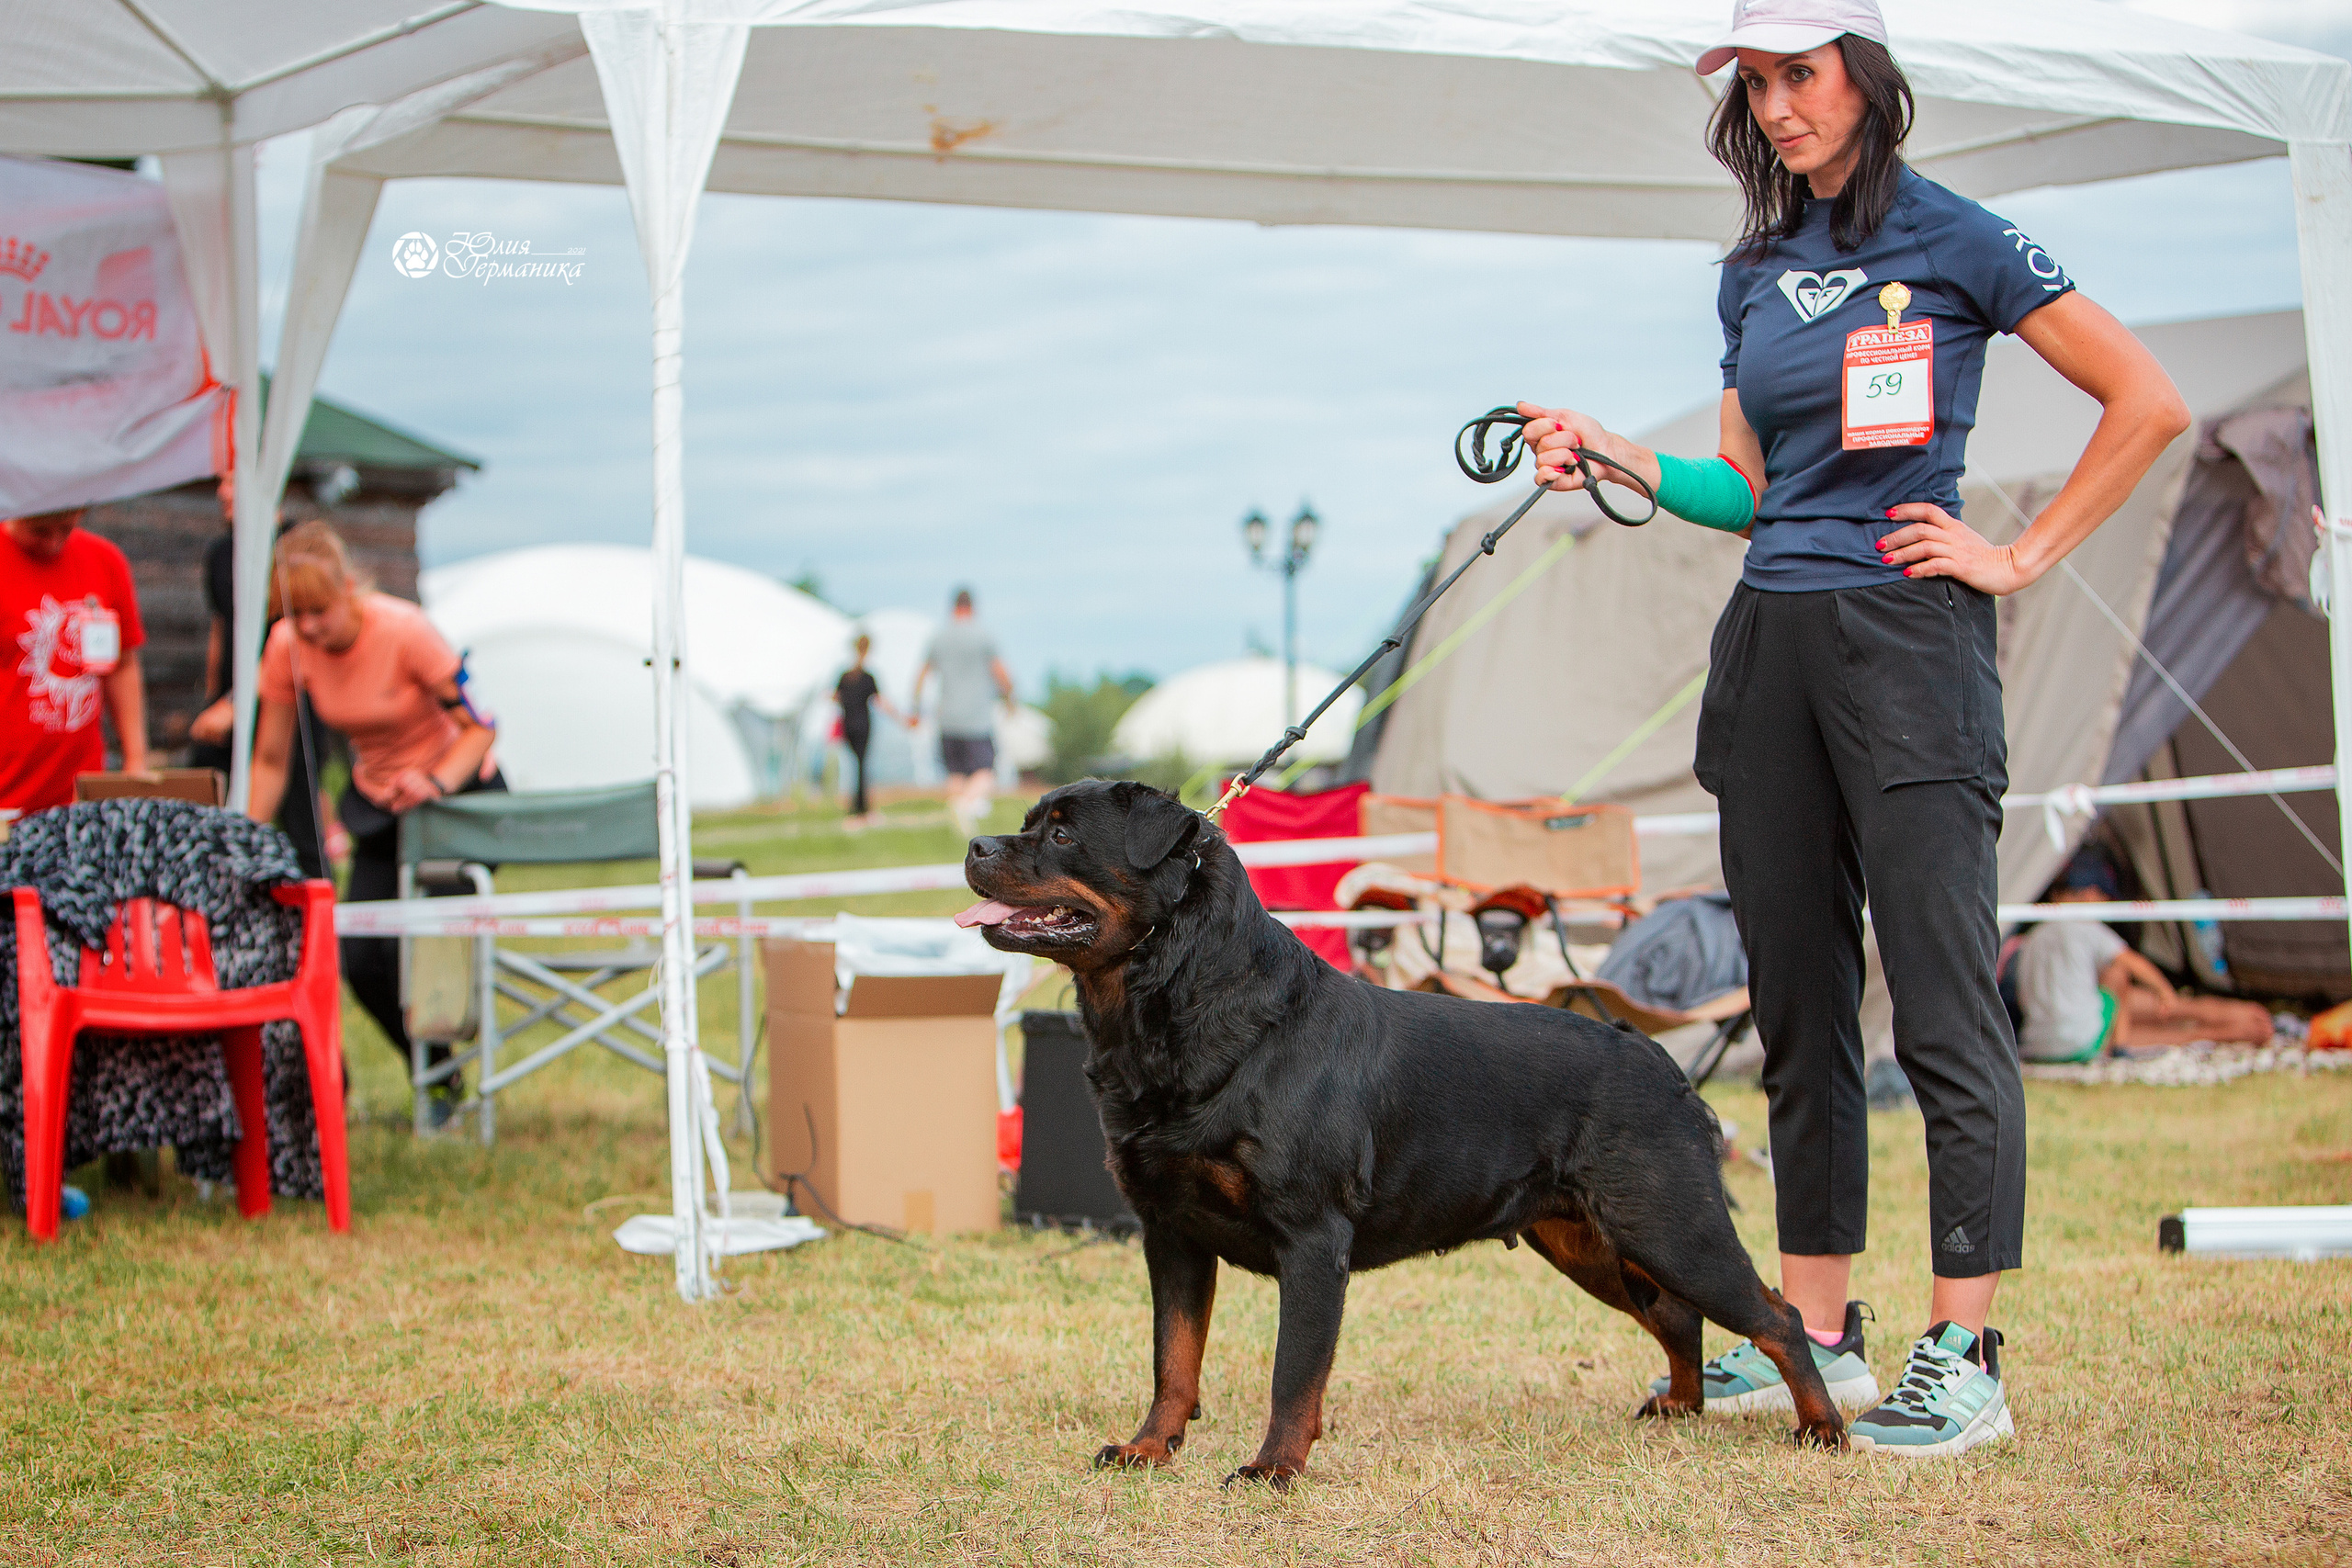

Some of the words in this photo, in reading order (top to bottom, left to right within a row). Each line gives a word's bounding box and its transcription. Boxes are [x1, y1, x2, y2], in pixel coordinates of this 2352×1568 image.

[1850, 328, 1928, 347] ТРАПЕЗА
[1846, 345, 1913, 359] ПРОФЕССИОНАЛЬНЫЙ
[1913, 344, 1931, 352] КОРМ
[1871, 354, 1899, 363] ЧЕСТНОЙ
[1866, 372, 1902, 398] 59
[1941, 1243, 1975, 1254] adidas
